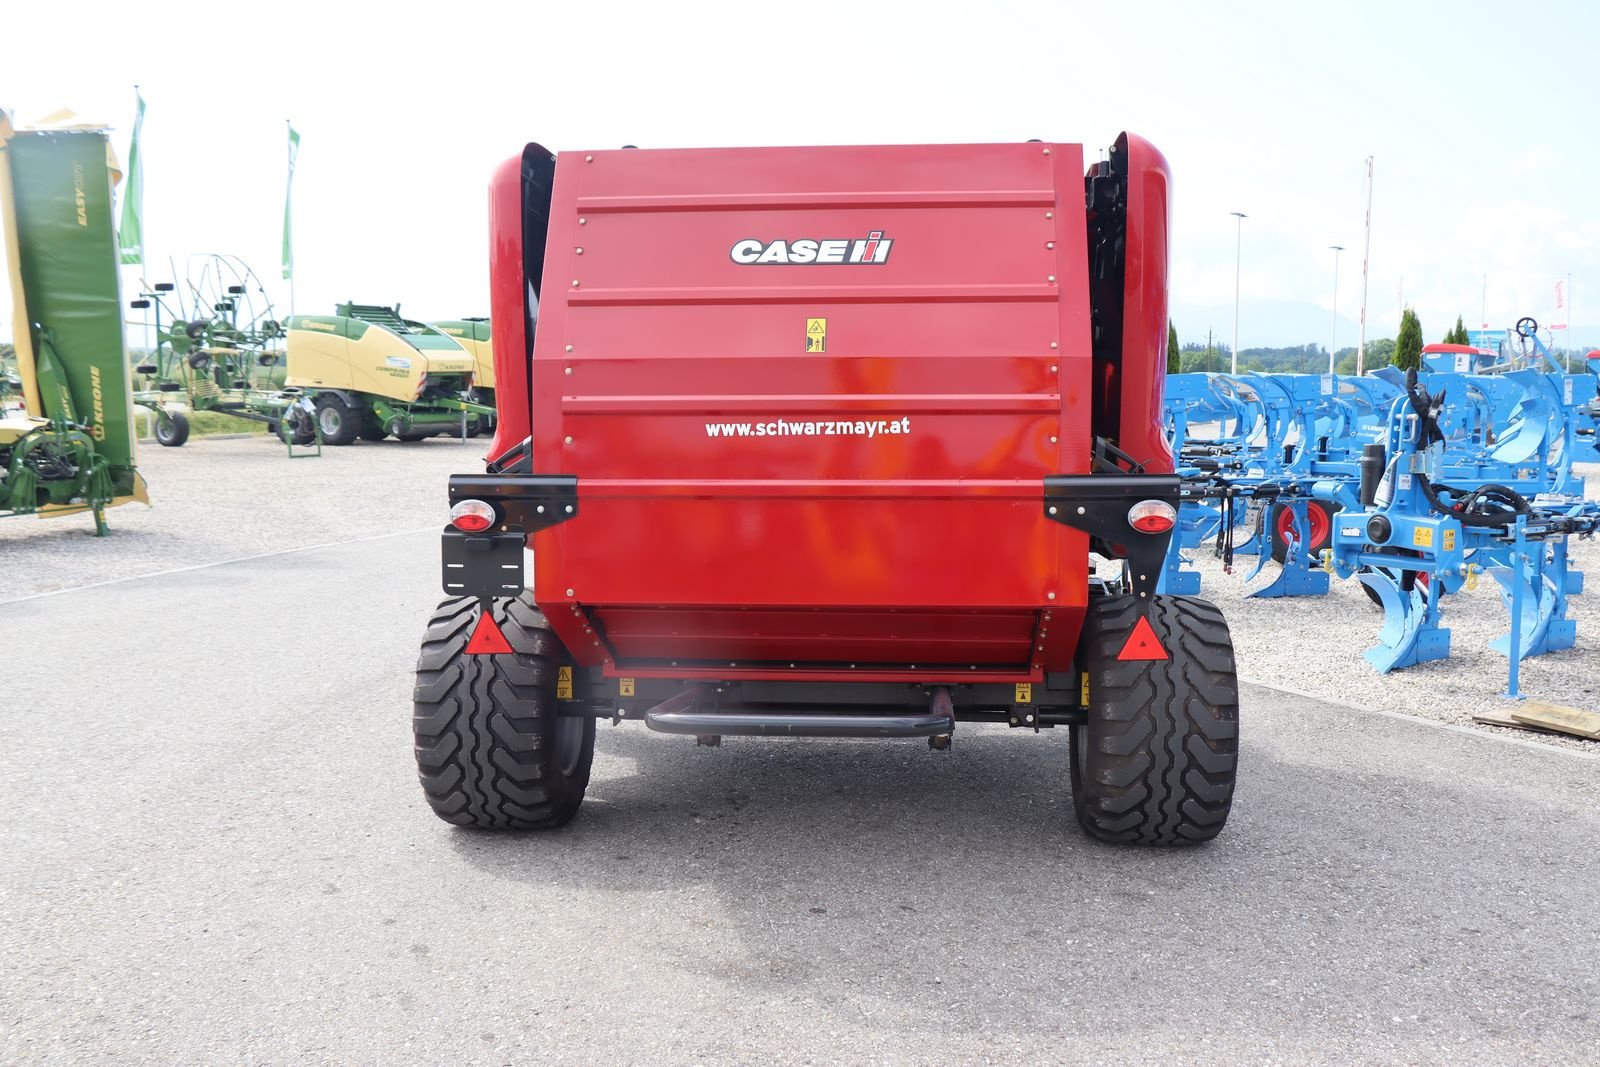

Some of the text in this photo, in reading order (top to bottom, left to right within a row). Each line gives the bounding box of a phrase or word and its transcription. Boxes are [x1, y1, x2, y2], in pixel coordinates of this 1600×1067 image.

[731, 239, 849, 264] CASE
[90, 365, 104, 425] KRONE
[705, 416, 911, 438] www.schwarzmayr.at
